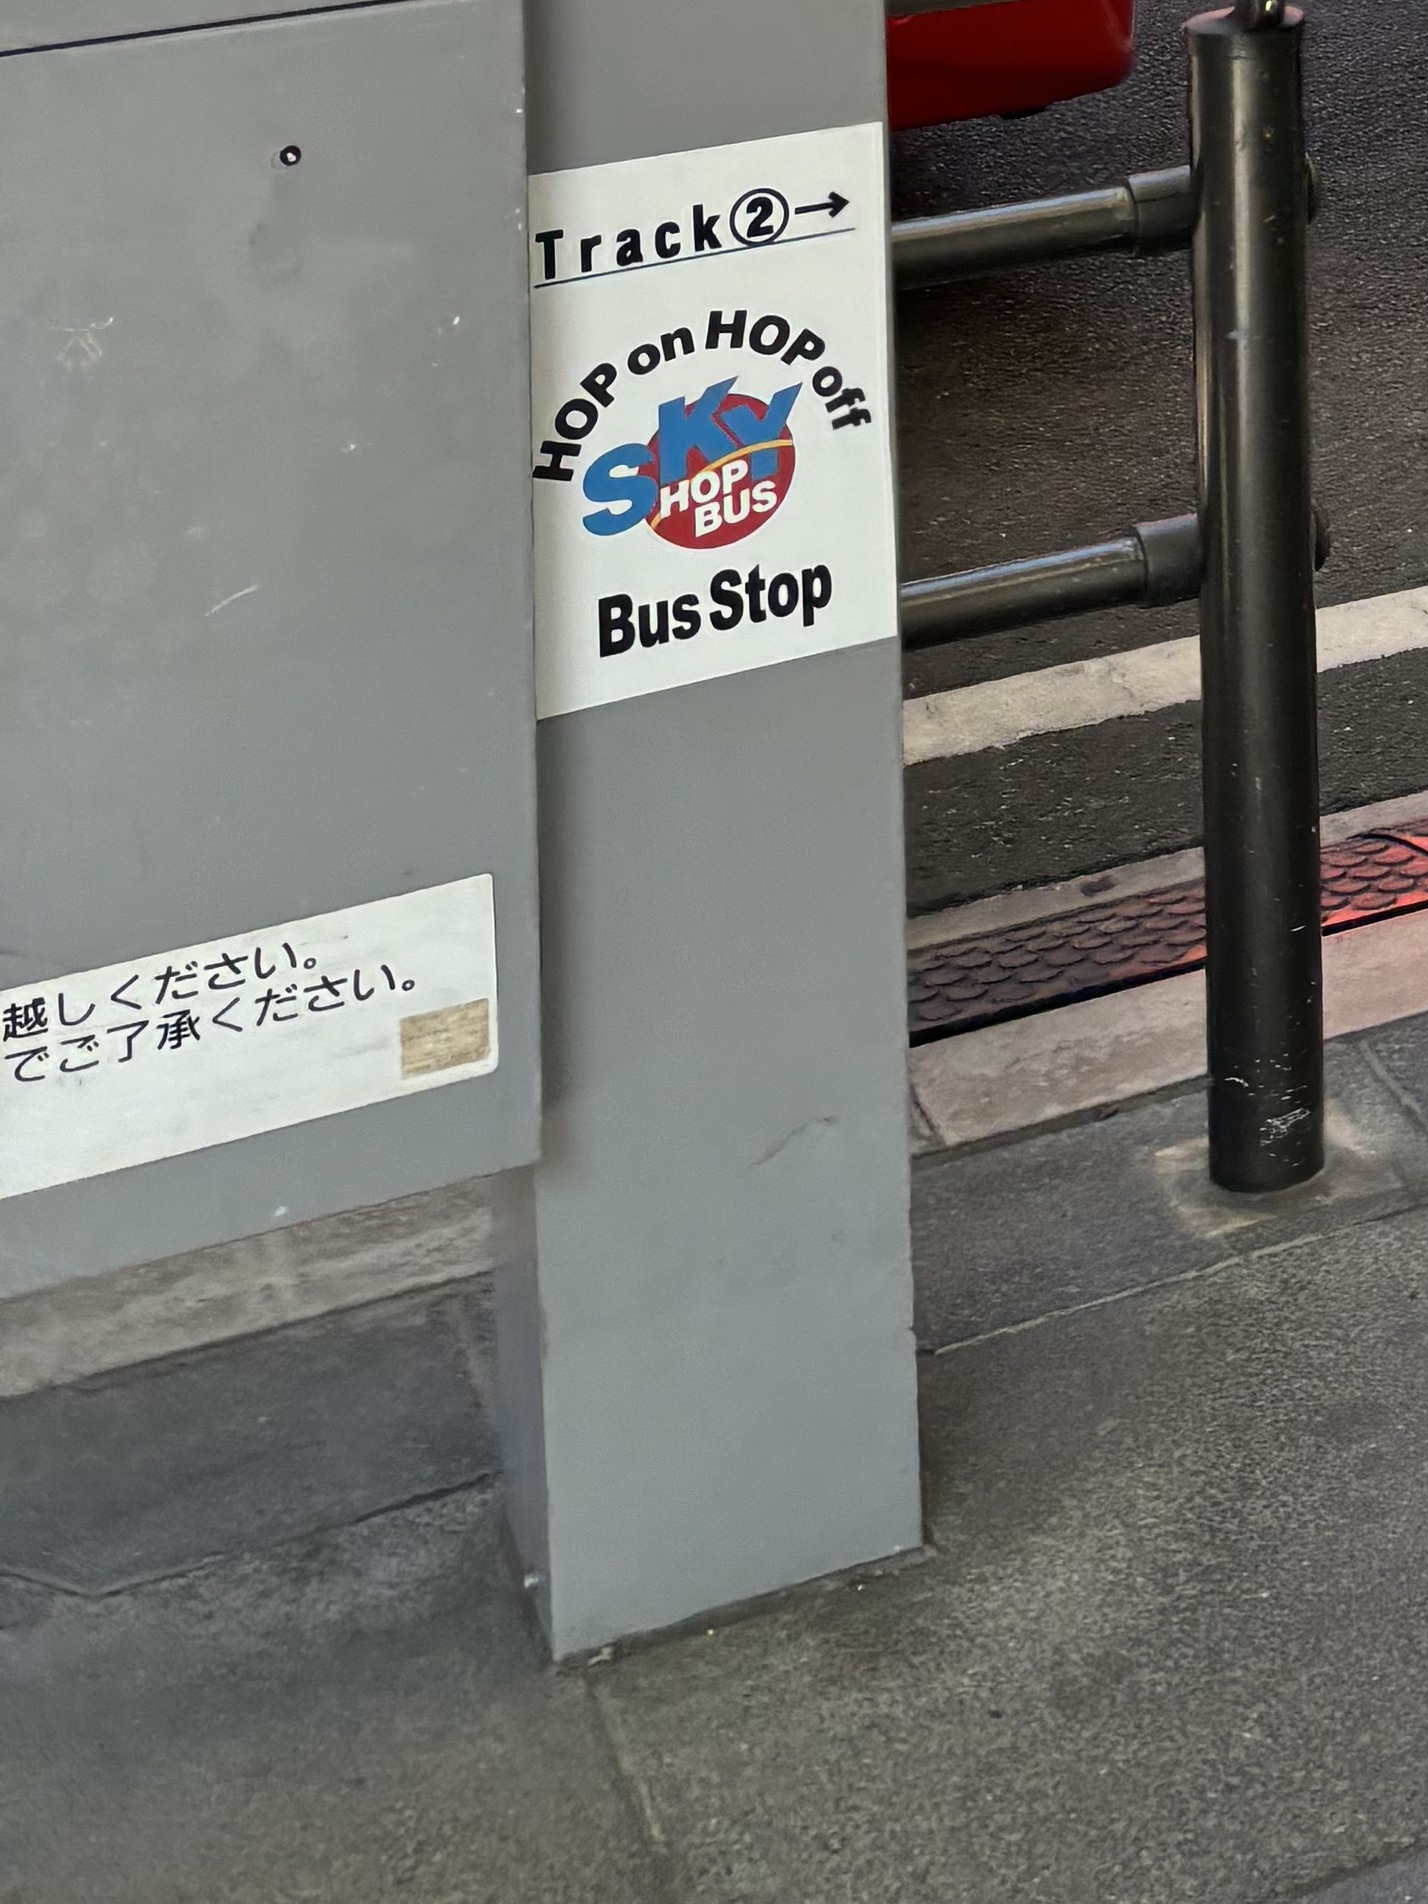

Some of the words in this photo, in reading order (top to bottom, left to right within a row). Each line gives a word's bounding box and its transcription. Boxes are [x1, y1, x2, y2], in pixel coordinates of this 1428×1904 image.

[535, 204, 721, 280] Track
[532, 362, 618, 482] HOP
[627, 325, 695, 376] on
[705, 309, 825, 367] HOP
[811, 365, 872, 431] off
[582, 375, 803, 536] SKY
[658, 459, 749, 518] HOP
[694, 480, 778, 538] BUS
[598, 592, 700, 658] Bus
[708, 563, 833, 632] Stop
[2, 942, 317, 1042] 越しください。
[3, 965, 416, 1082] でご了承ください。
